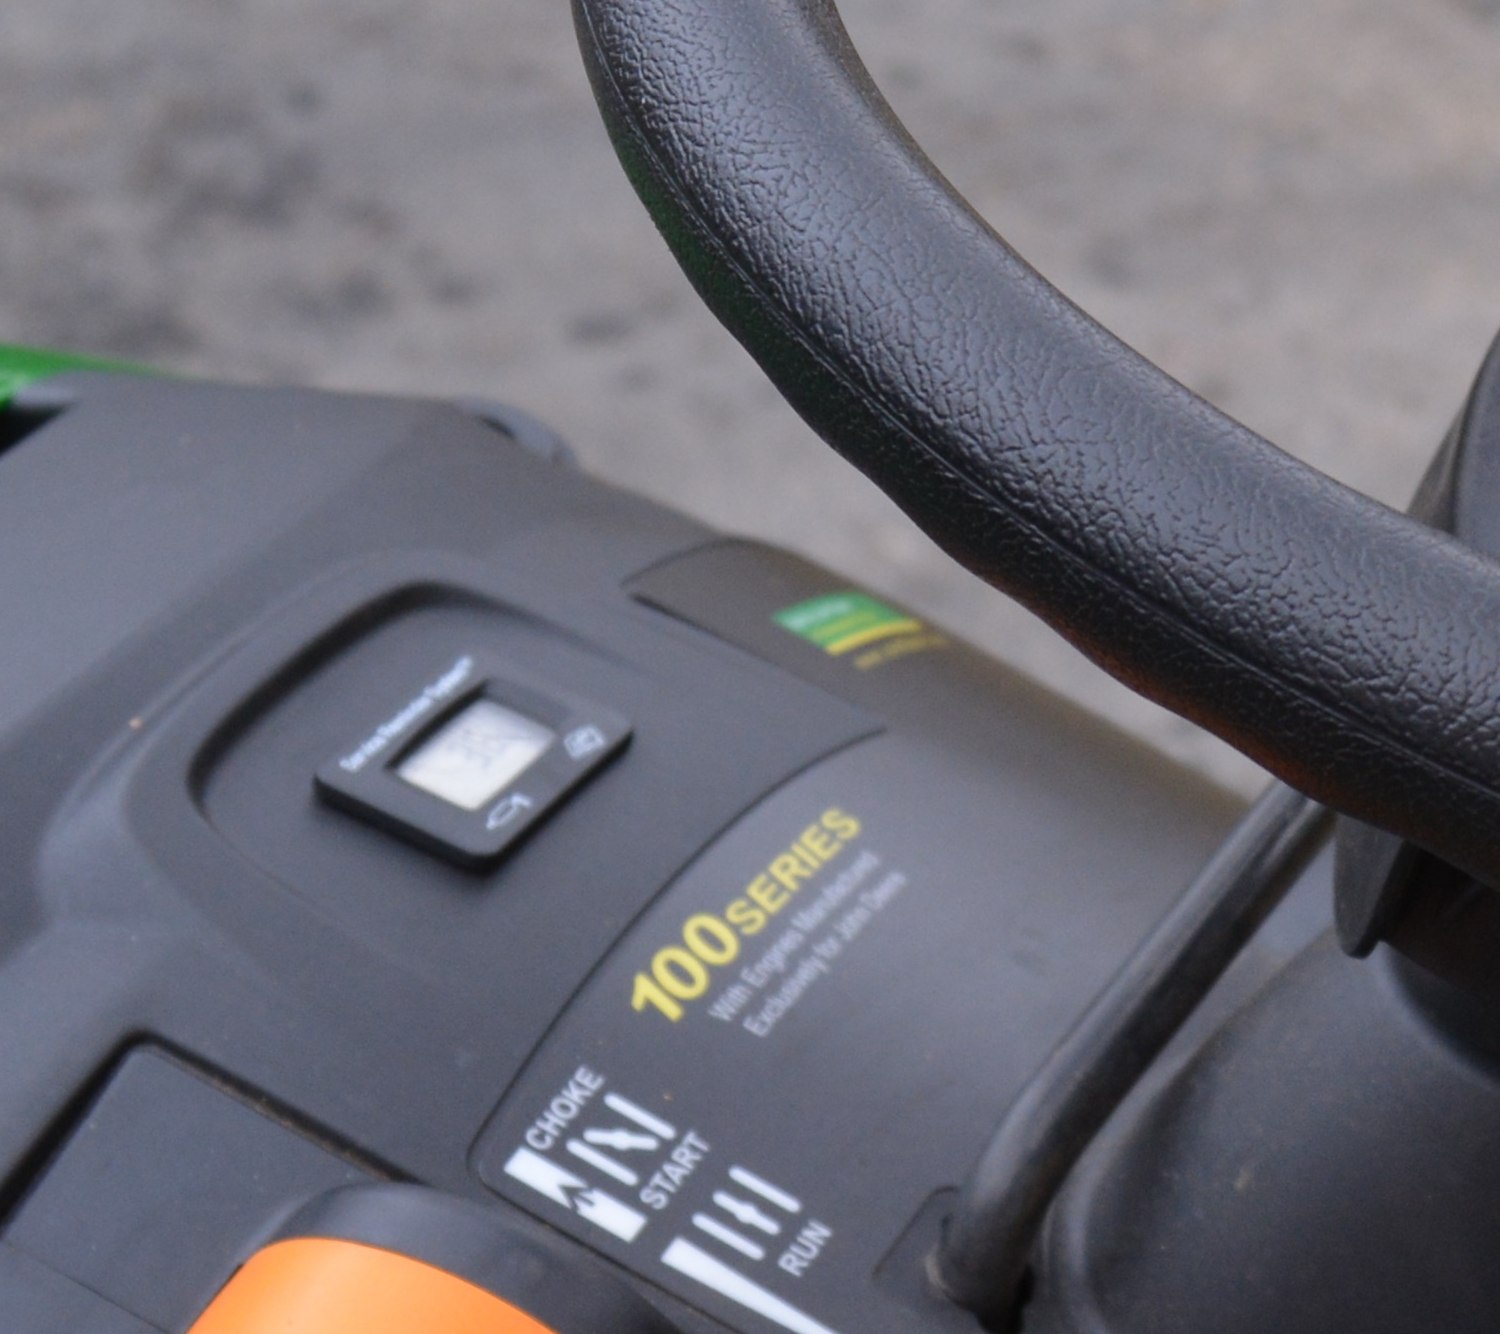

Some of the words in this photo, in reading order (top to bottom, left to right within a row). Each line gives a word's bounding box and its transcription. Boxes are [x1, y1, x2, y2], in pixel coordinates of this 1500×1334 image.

[630, 911, 741, 1023] 100
[725, 806, 862, 936] SERIES
[708, 983, 752, 1023] With
[524, 1064, 605, 1153] CHOKE
[639, 1128, 712, 1211] START
[778, 1219, 833, 1279] RUN
